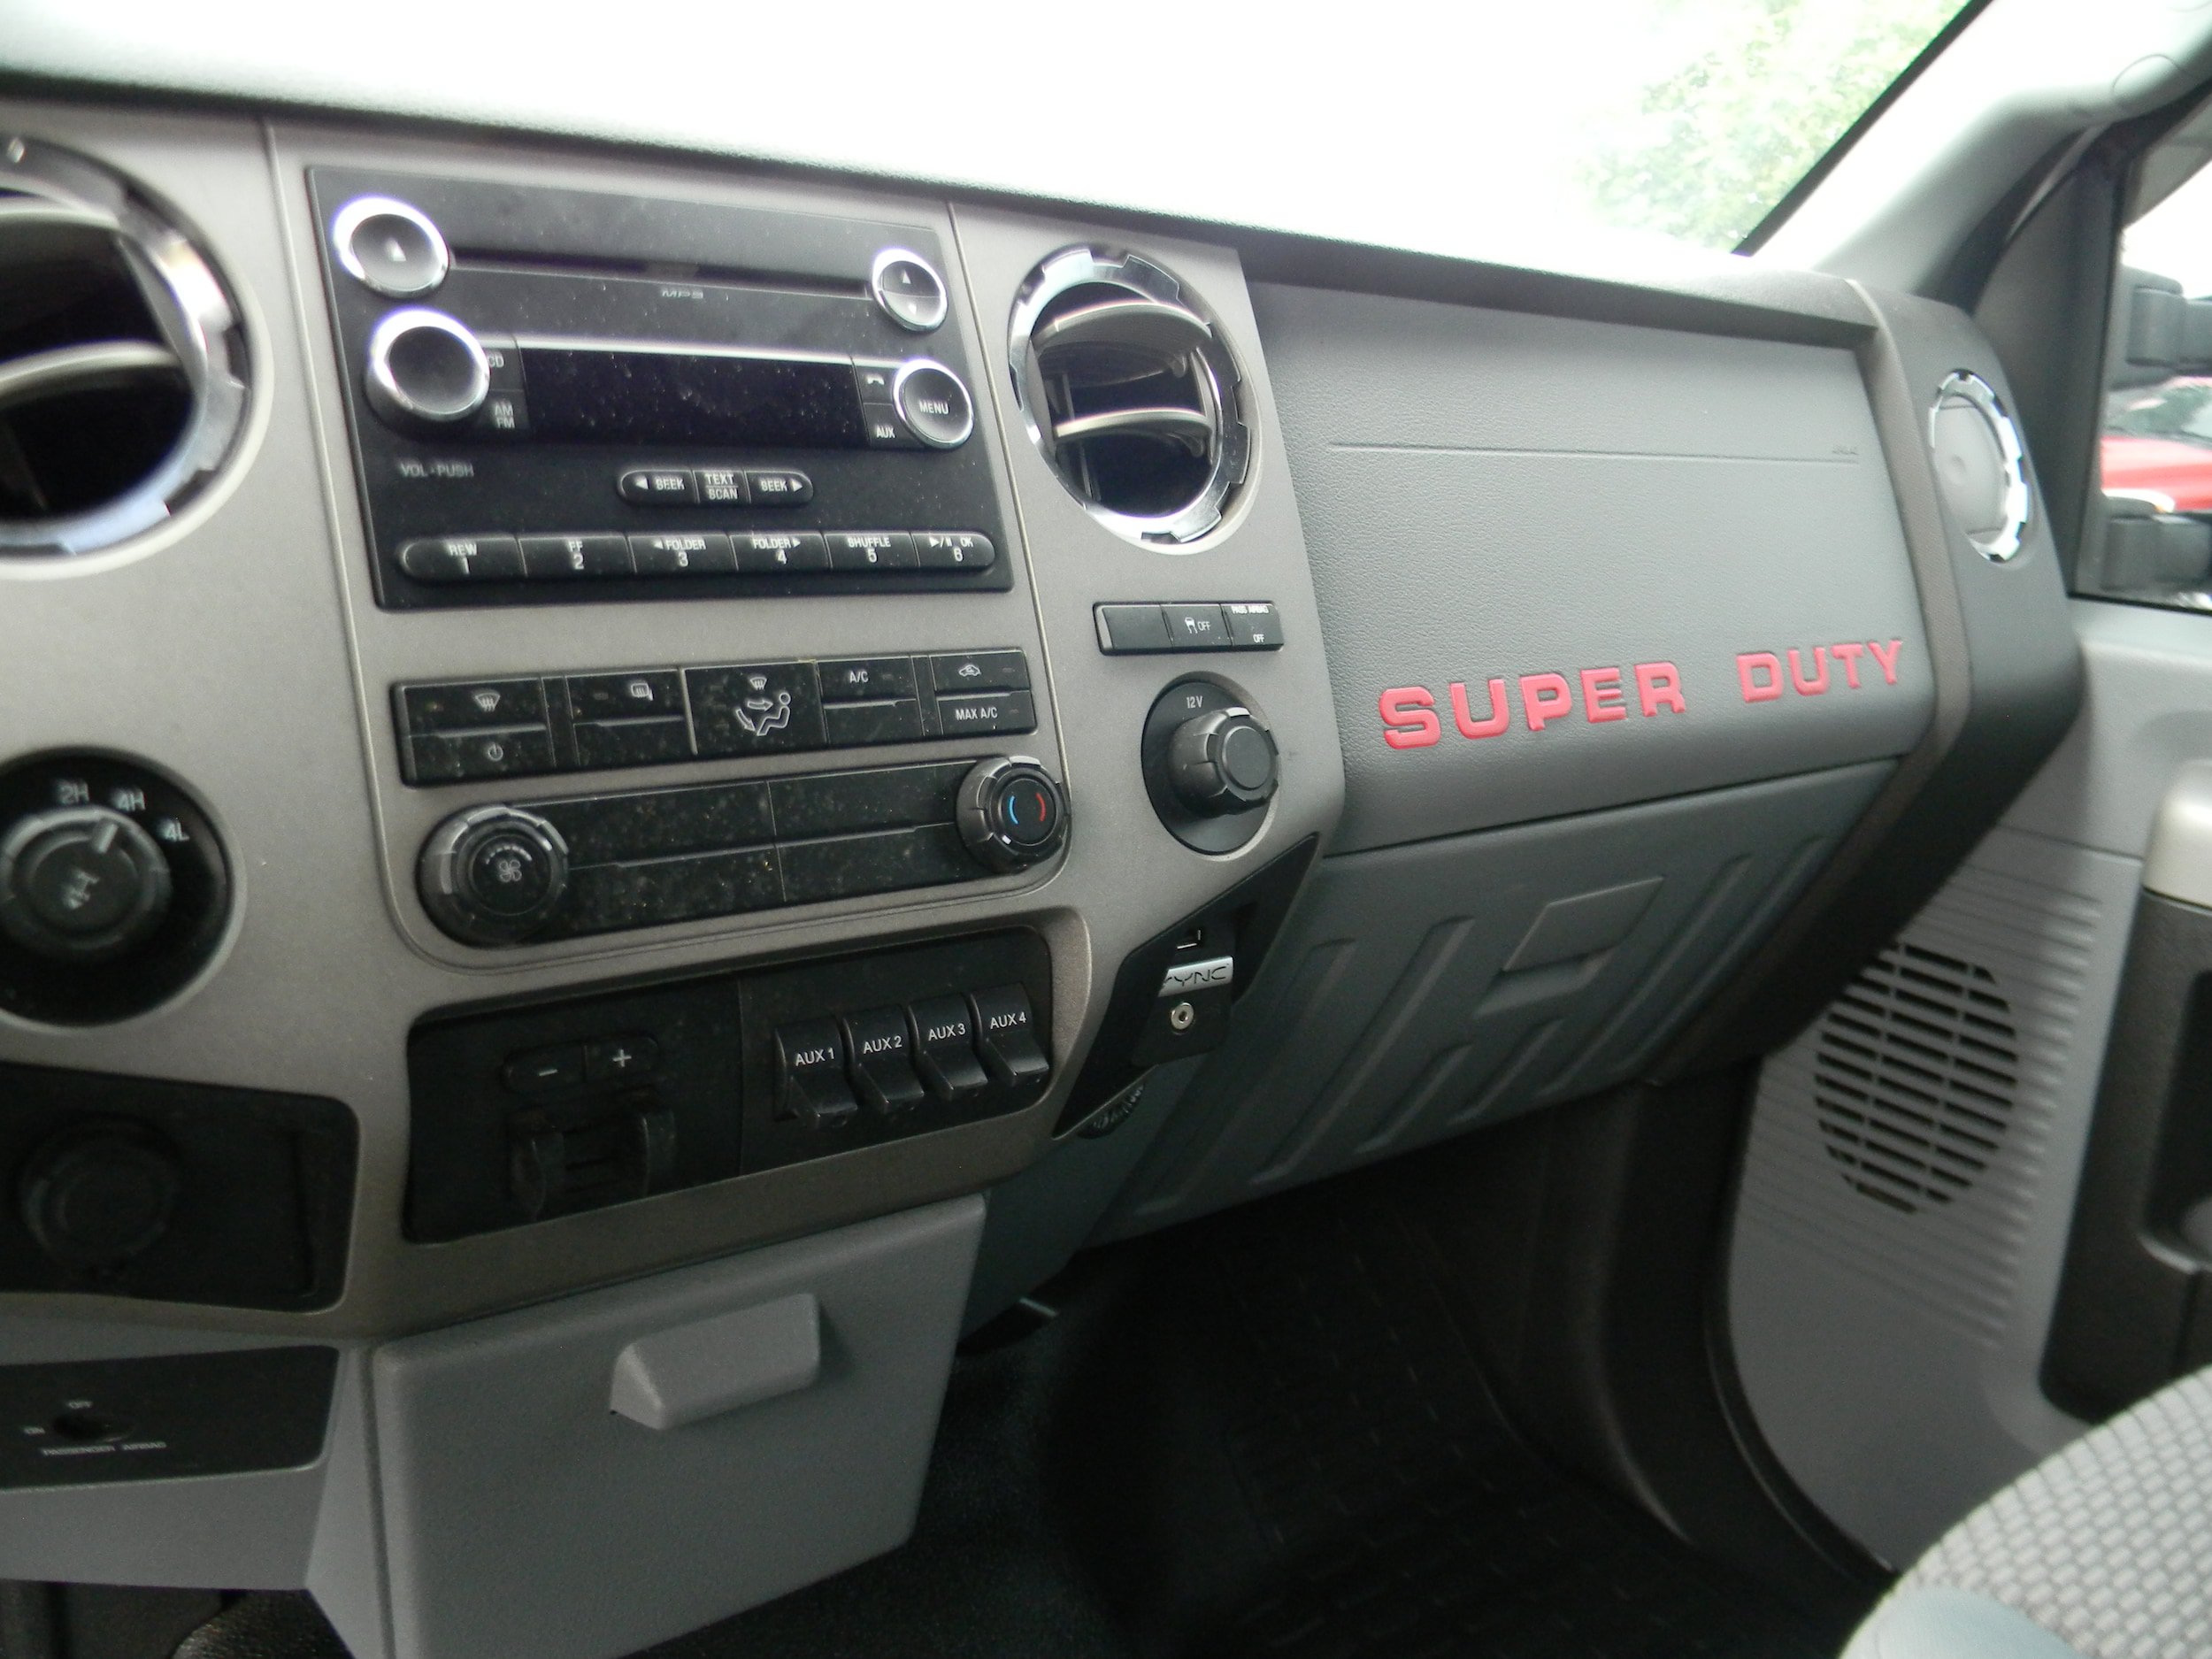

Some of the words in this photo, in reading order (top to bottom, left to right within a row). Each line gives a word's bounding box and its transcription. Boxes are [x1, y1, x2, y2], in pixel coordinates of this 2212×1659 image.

[495, 402, 514, 416] AM
[919, 399, 949, 415] MENU
[497, 417, 516, 429] FM
[876, 425, 895, 439] AUX
[400, 461, 428, 477] VOL
[436, 463, 475, 478] PUSH
[655, 477, 685, 490] SEEK
[706, 472, 734, 485] TEXT
[760, 479, 787, 492] SEEK
[708, 488, 738, 500] SCAN
[568, 539, 583, 552] FF
[665, 538, 707, 550] FOLDER
[753, 537, 791, 549] FOLDER
[848, 536, 891, 548] SHUFFLE
[960, 536, 974, 547] OK
[447, 542, 478, 557] REW
[866, 547, 878, 564] 5
[952, 546, 964, 563] 6
[572, 552, 585, 570] 2
[678, 550, 689, 567] 3
[775, 549, 787, 565] 4
[461, 557, 471, 574] 1
[1197, 621, 1211, 631] OFF
[1253, 634, 1265, 643] OFF
[849, 670, 869, 684] A/C
[1379, 661, 1686, 750] SUPER
[1736, 638, 1905, 704] DUTY
[1186, 695, 1203, 709] 12V
[955, 708, 979, 721] MAX
[979, 706, 998, 719] A/C
[989, 1014, 1018, 1030] AUX
[1018, 1011, 1026, 1024] 4
[928, 1025, 956, 1041] AUX
[956, 1023, 966, 1036] 3
[863, 1037, 892, 1055] AUX
[894, 1035, 902, 1049] 2
[795, 1049, 825, 1067] AUX
[827, 1047, 835, 1060] 1
